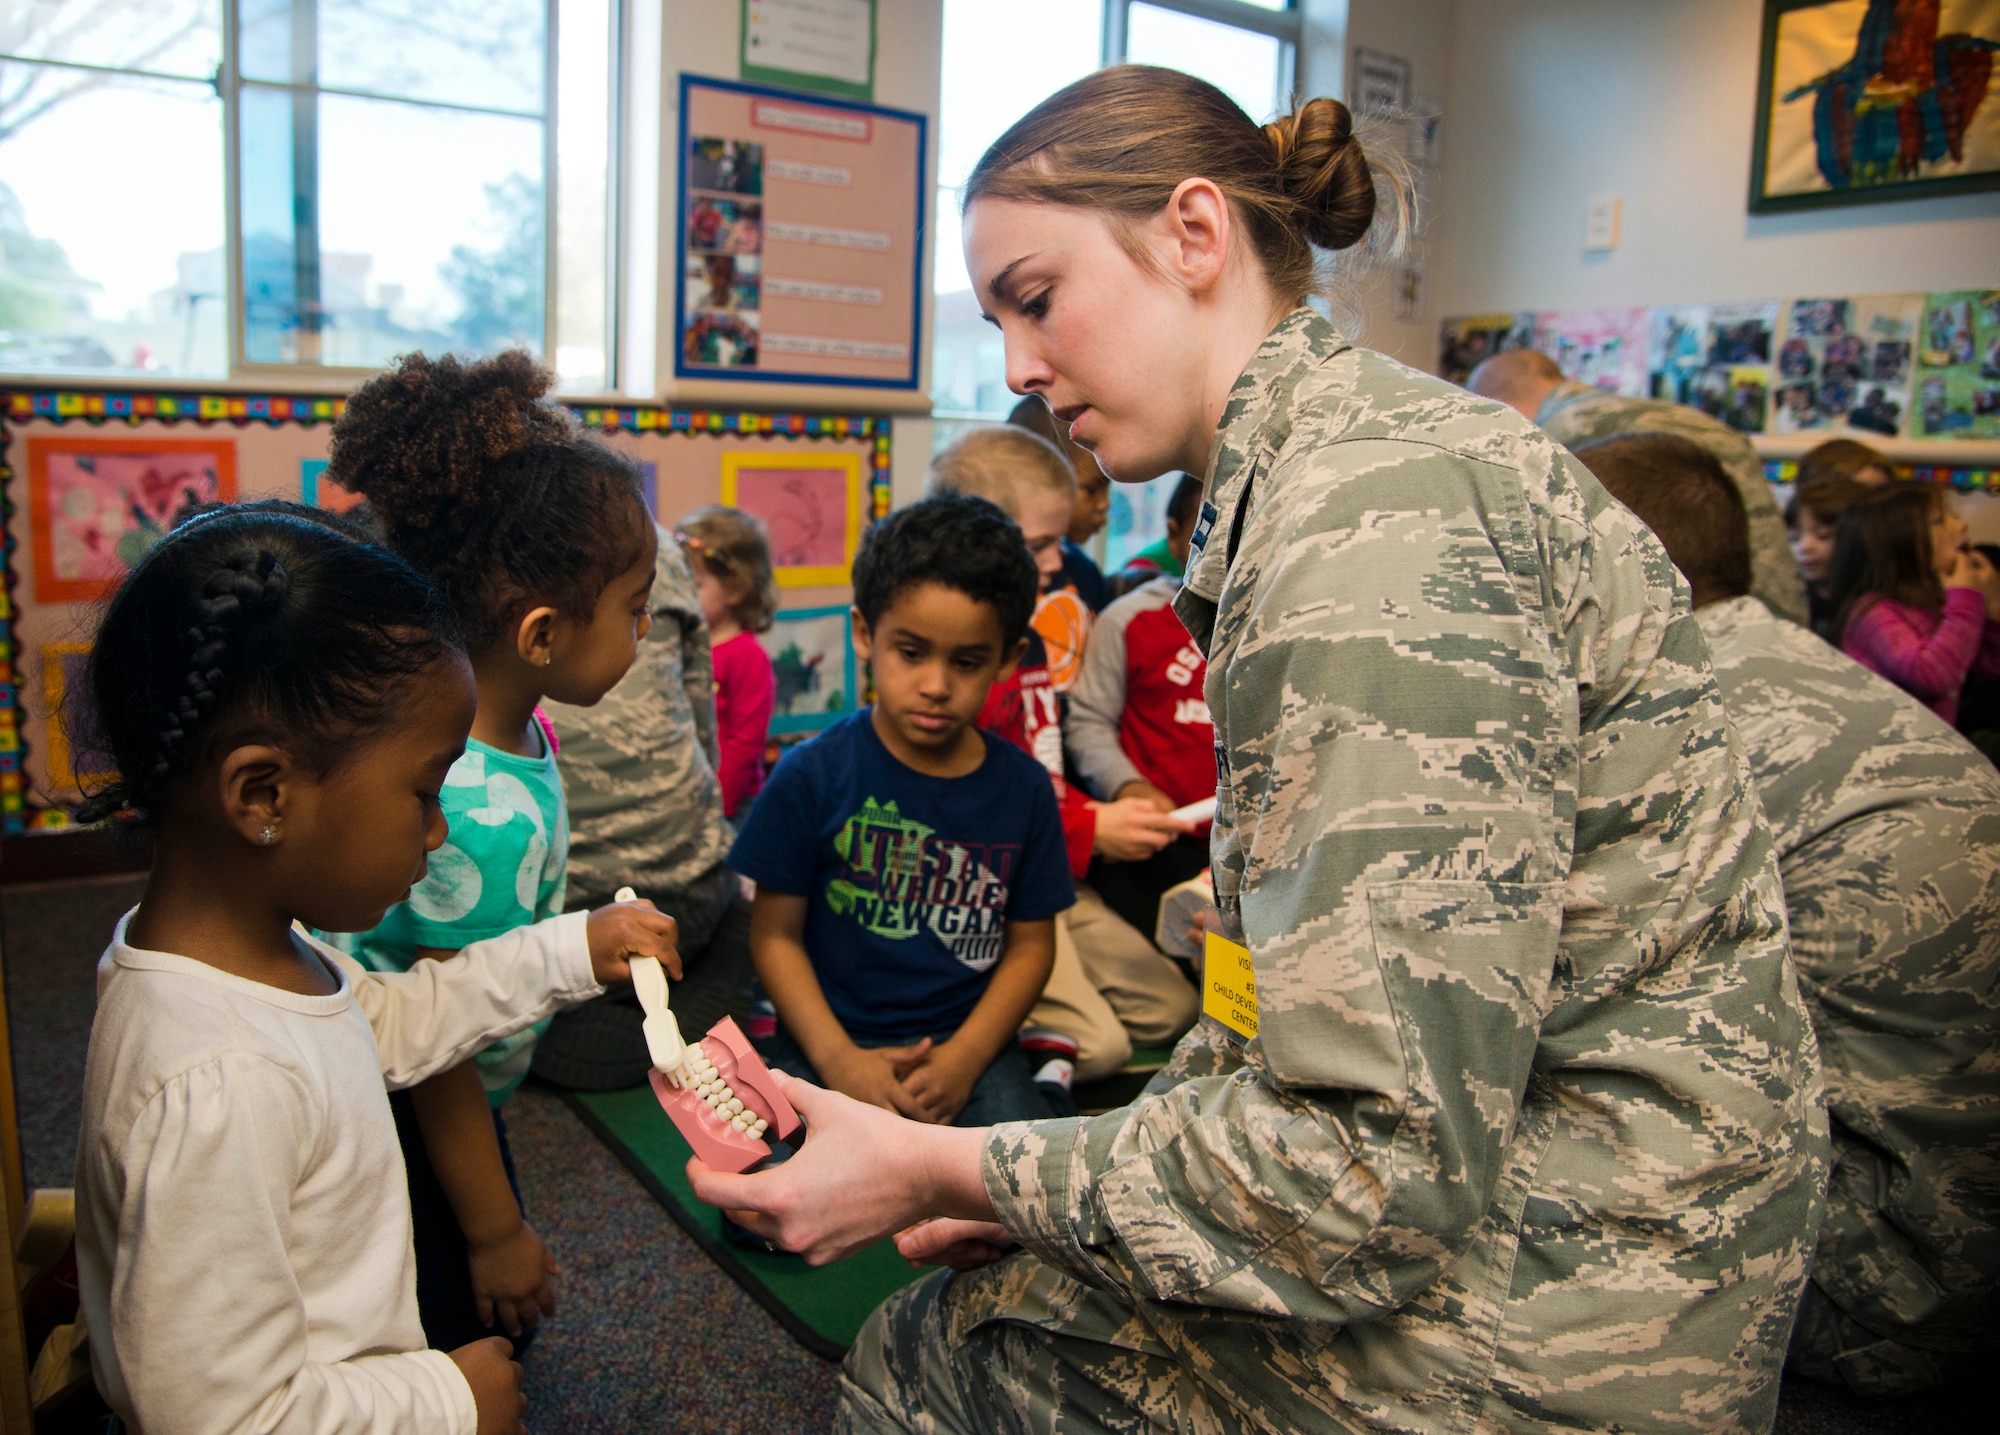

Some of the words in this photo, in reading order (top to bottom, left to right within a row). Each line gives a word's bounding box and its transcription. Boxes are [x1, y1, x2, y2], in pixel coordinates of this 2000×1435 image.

[1214, 982, 1234, 1000] CHILD
[1246, 981, 1255, 995] #3
[1232, 1009, 1259, 1033] CENTER
